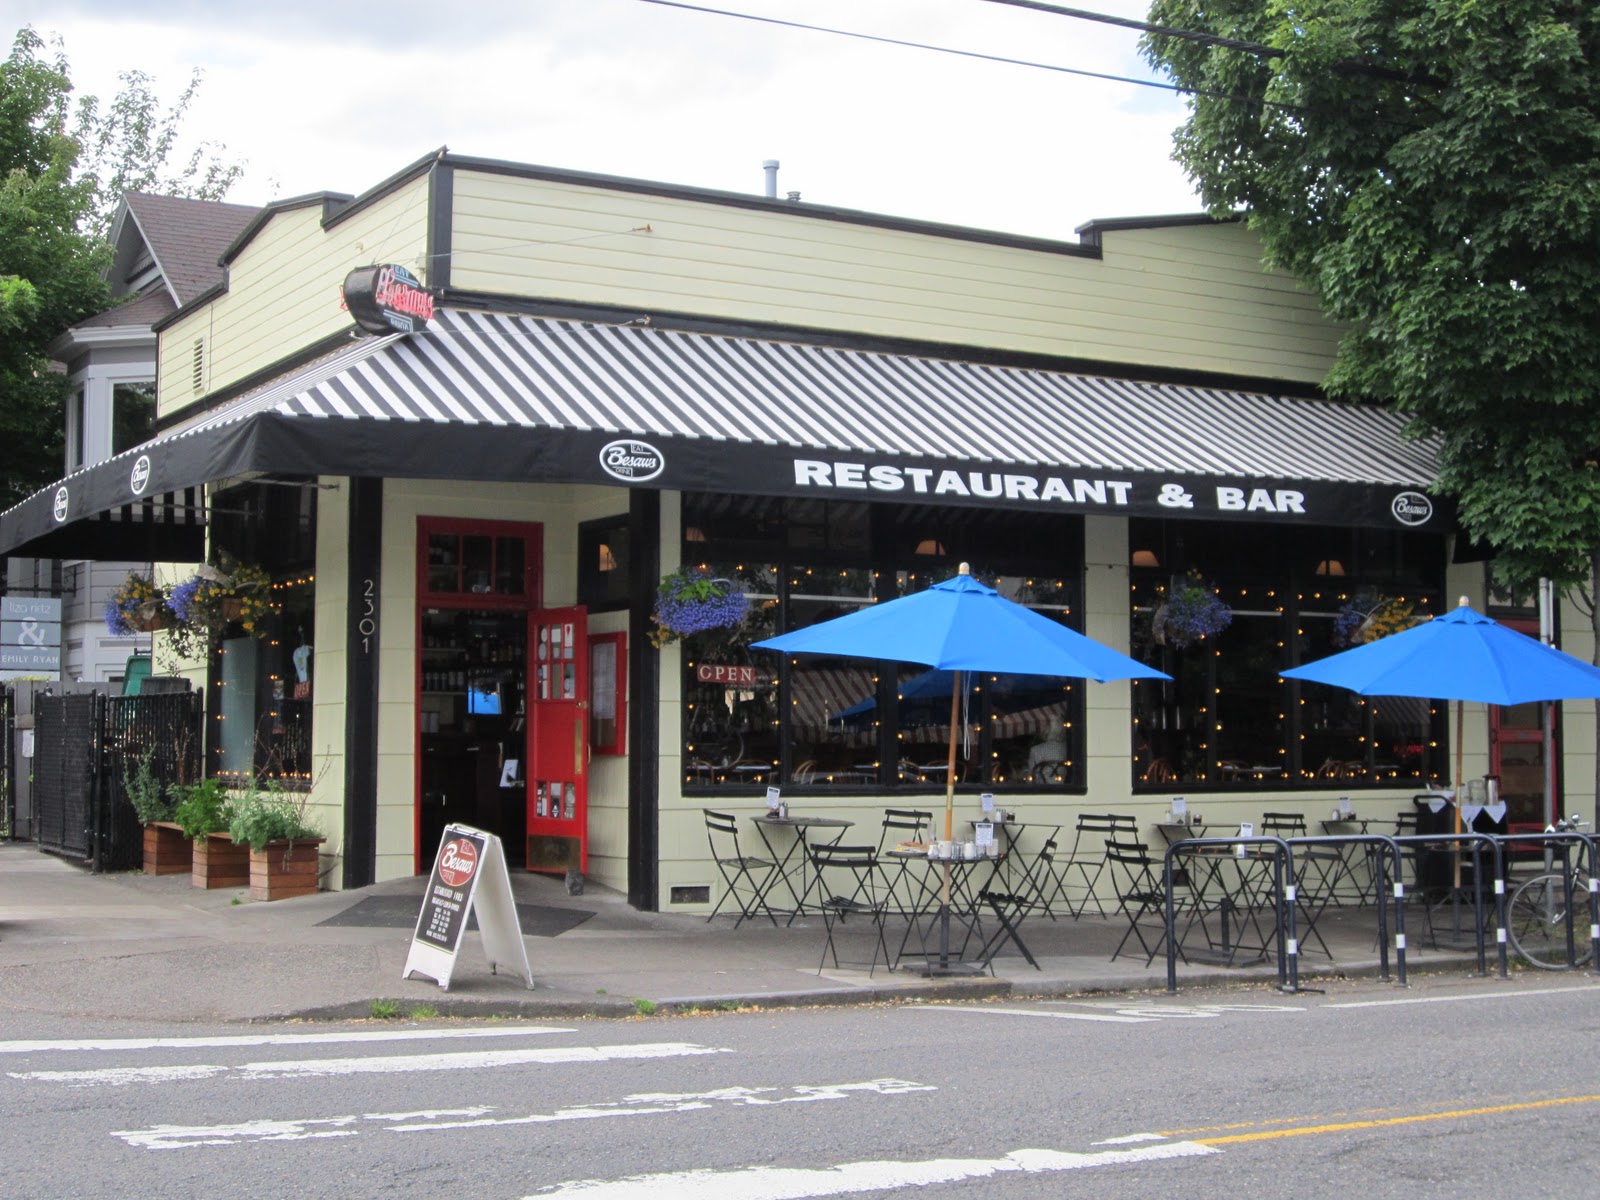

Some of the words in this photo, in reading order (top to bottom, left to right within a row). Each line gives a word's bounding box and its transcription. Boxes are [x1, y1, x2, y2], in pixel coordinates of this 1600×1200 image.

[607, 447, 656, 468] Besaws
[794, 459, 1132, 505] RESTAURANT
[1157, 483, 1194, 508] &
[1216, 486, 1306, 513] BAR
[359, 579, 375, 654] 2301
[18, 616, 48, 651] &
[2, 655, 29, 663] EMILY
[33, 655, 59, 664] RYAN
[700, 665, 752, 681] OPEN
